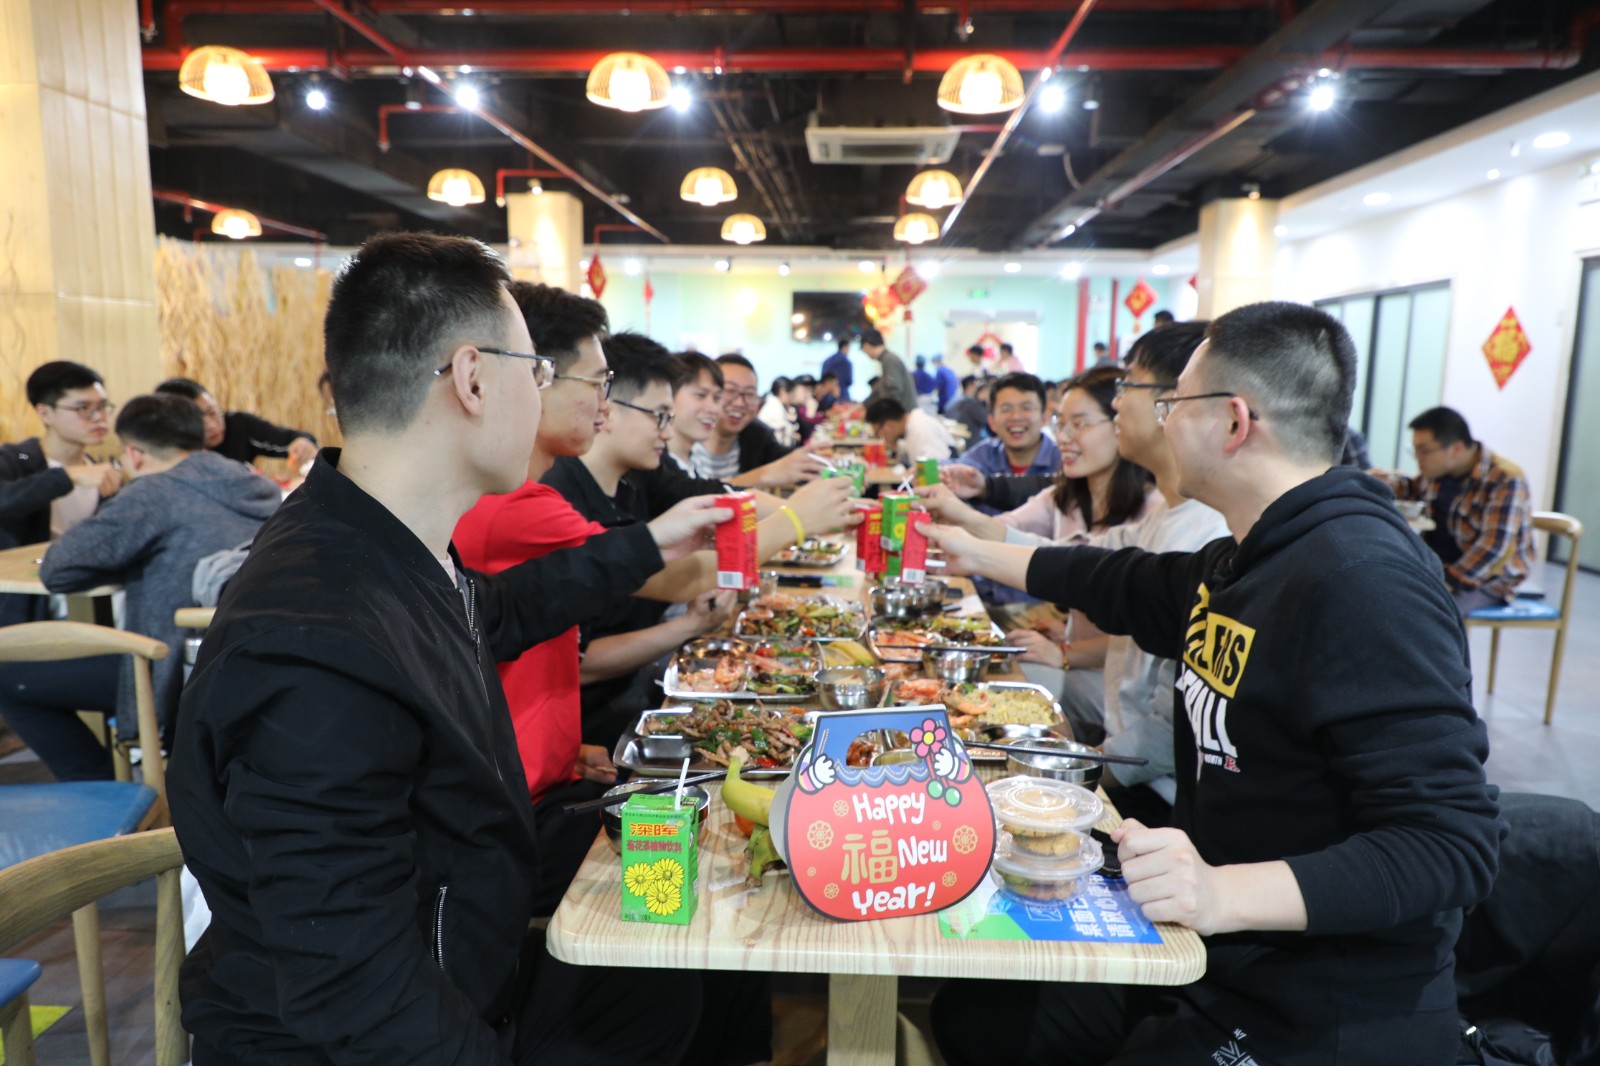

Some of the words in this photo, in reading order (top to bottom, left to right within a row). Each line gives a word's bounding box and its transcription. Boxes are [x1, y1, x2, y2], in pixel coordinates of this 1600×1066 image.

[852, 792, 926, 825] Happy
[629, 823, 679, 836] 深晖
[841, 829, 898, 885] 福
[897, 835, 947, 868] New
[1068, 897, 1104, 938] 桌面已
